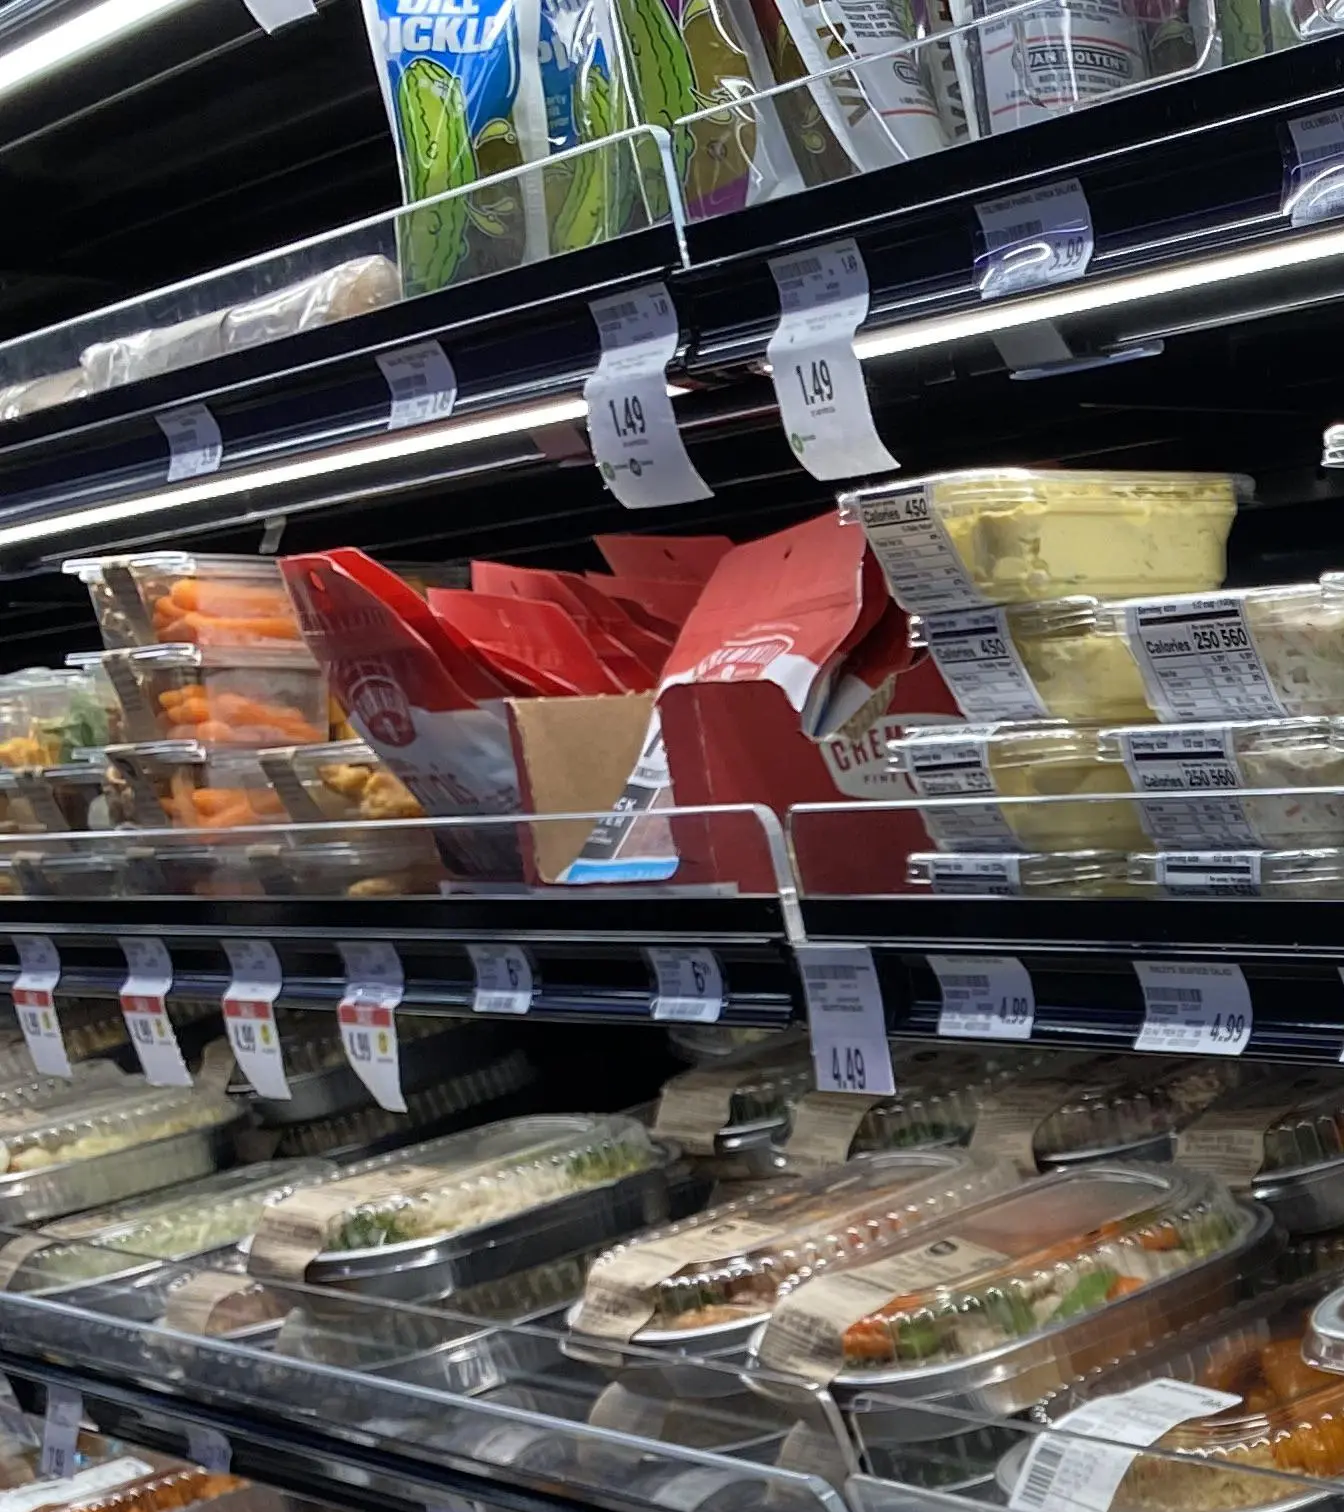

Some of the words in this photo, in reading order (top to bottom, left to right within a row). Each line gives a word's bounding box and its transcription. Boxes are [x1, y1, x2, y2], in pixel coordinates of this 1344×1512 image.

[1048, 237, 1084, 273] 5.99
[796, 360, 834, 406] 1.49
[609, 396, 646, 437] 1.49
[905, 498, 928, 518] 450
[980, 639, 1004, 656] 450
[1146, 639, 1191, 654] Calories
[1194, 632, 1220, 649] 250
[1222, 629, 1248, 647] 560
[1209, 1012, 1245, 1042] 4.99
[831, 1047, 866, 1091] 4.49
